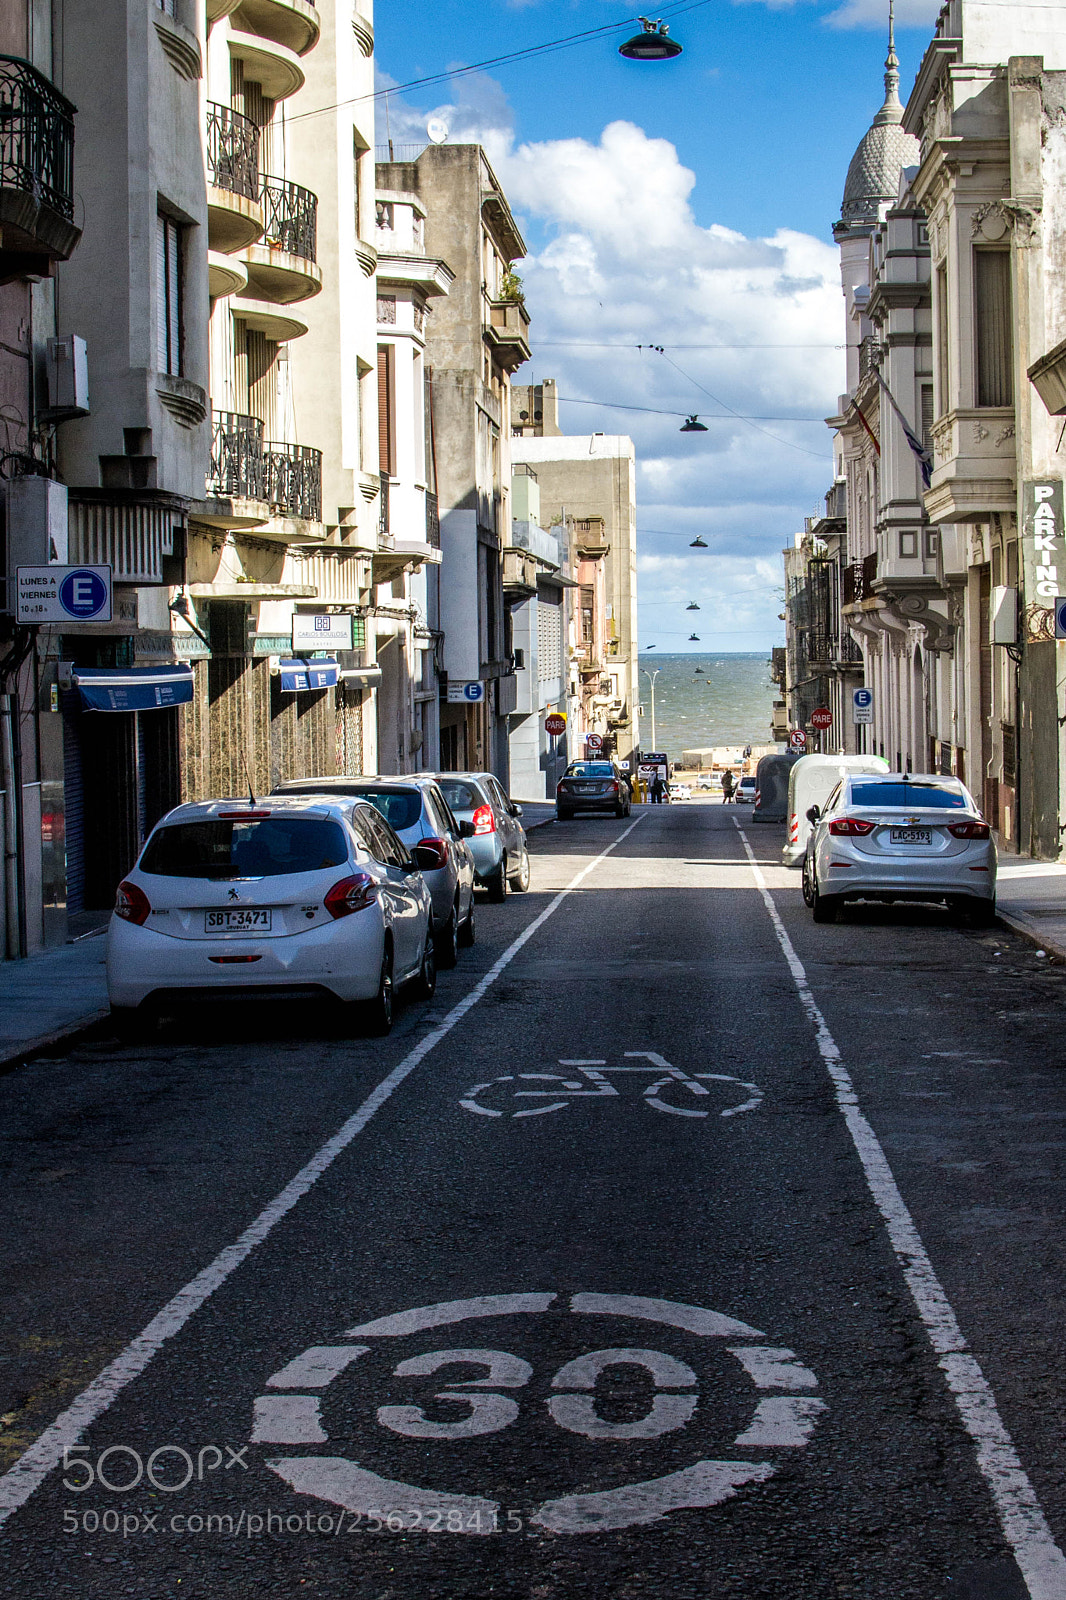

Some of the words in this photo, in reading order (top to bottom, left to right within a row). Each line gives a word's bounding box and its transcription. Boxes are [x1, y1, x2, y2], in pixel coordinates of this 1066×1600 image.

[1033, 485, 1059, 597] PARKING
[20, 577, 48, 586] LUNES
[20, 591, 57, 599] VIERNES
[72, 577, 94, 605] E
[21, 605, 29, 613] 10
[35, 605, 43, 613] 18
[469, 685, 478, 696] E
[858, 692, 867, 703] E
[812, 714, 832, 723] PARE
[546, 720, 565, 729] PARE
[376, 1348, 700, 1440] 30
